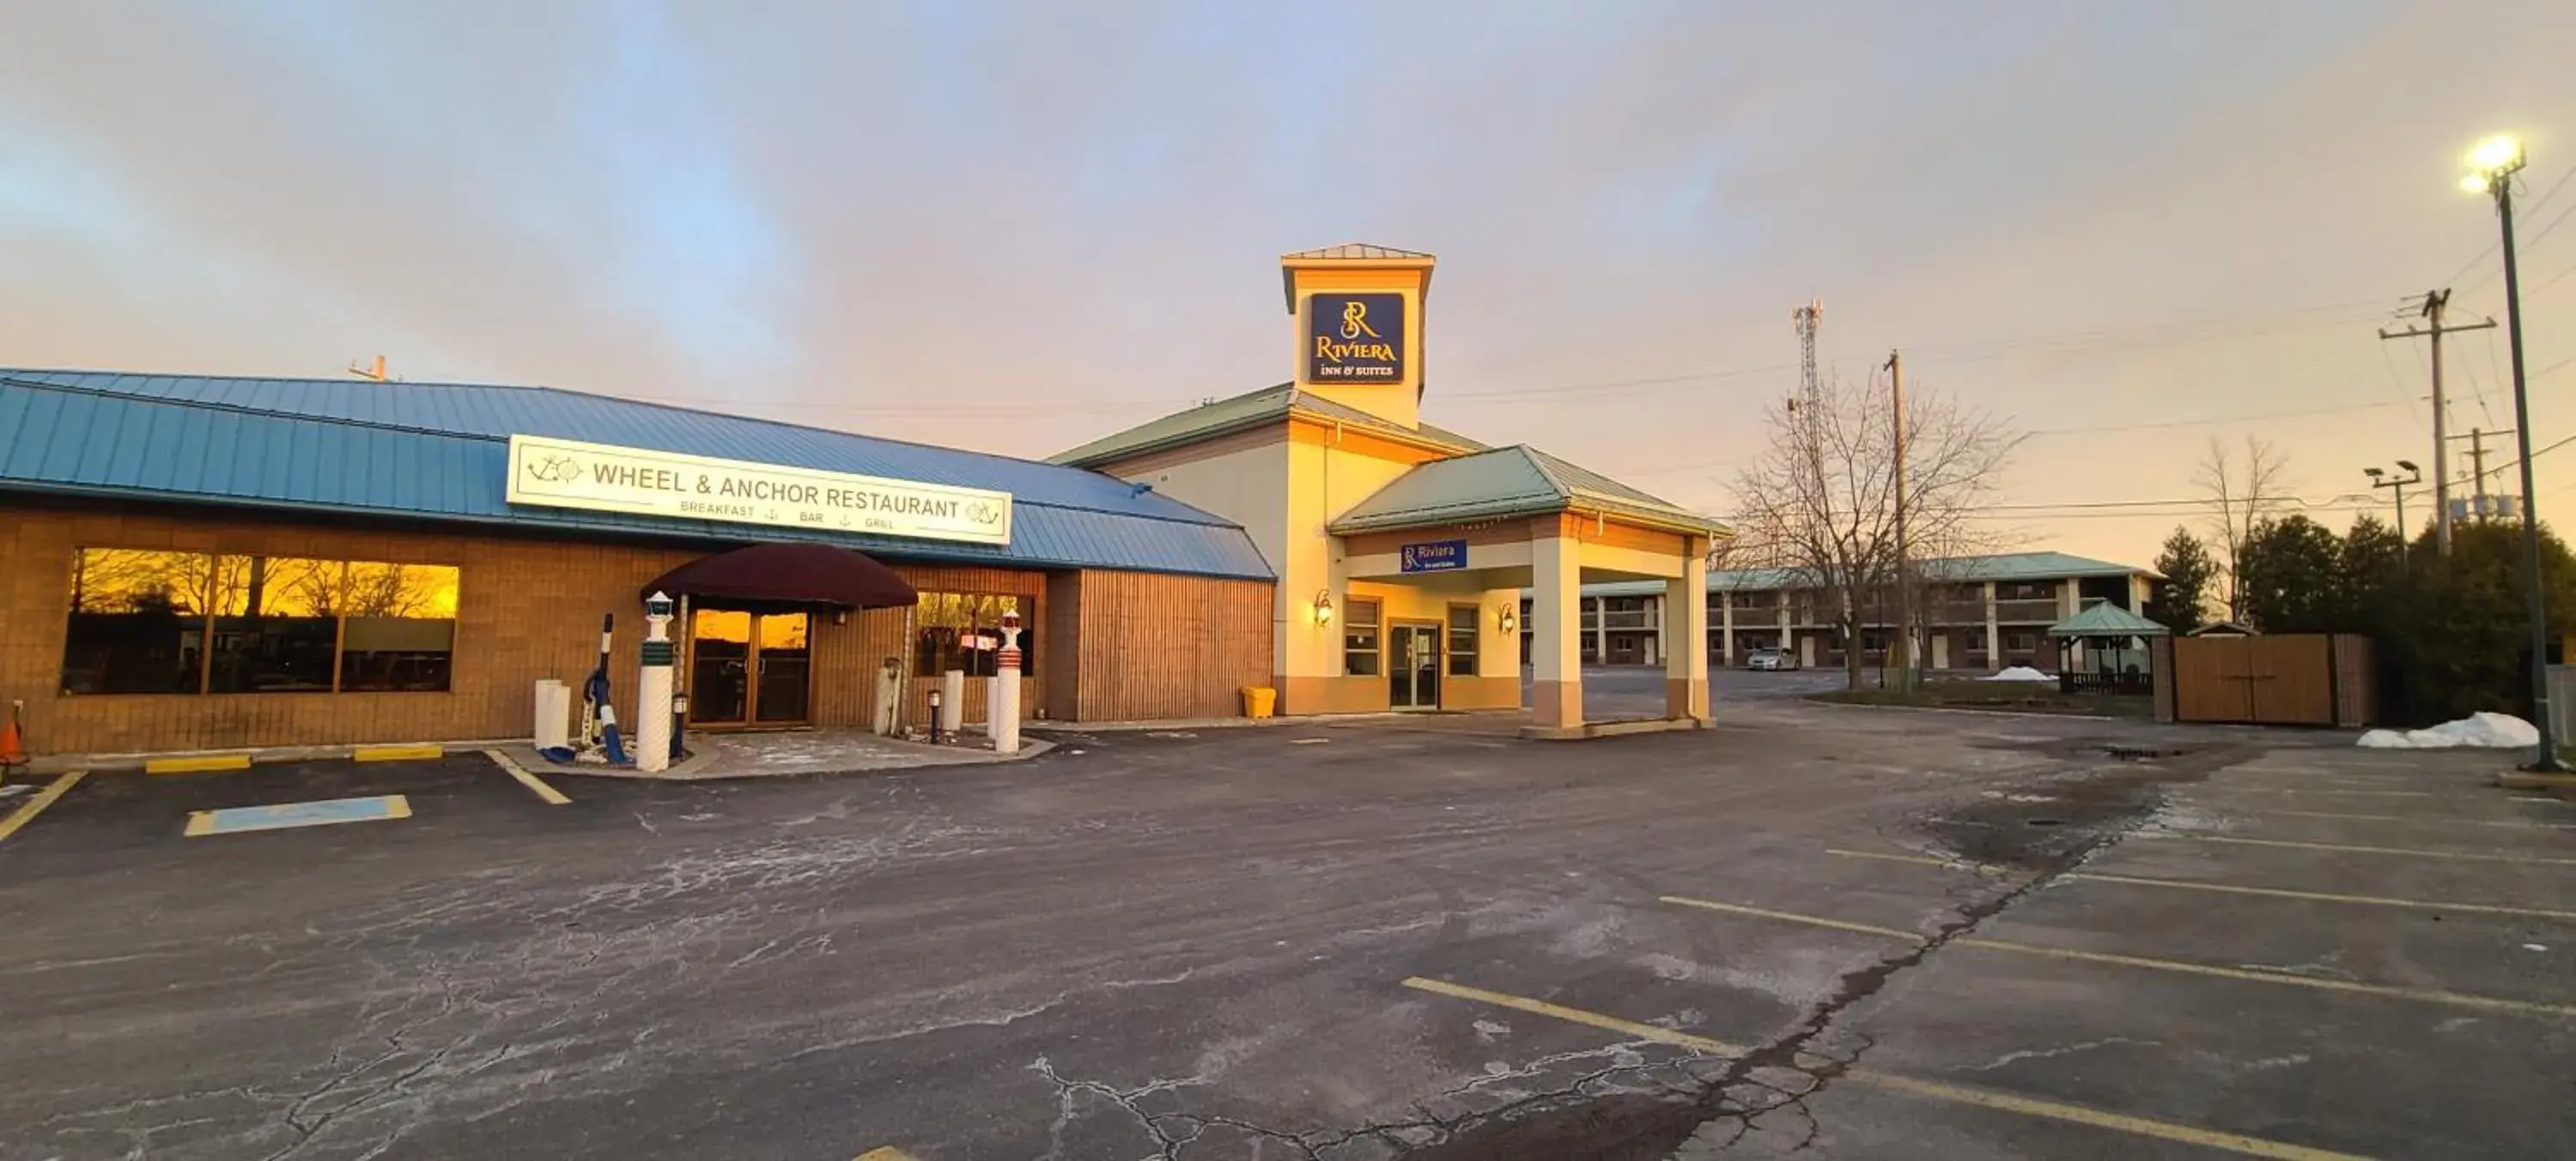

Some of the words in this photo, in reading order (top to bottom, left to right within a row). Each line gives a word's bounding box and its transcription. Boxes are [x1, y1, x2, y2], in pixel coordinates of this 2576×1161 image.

[1321, 364, 1341, 375] INN
[1356, 367, 1394, 375] SUITES
[593, 463, 688, 493] WHEEL
[696, 474, 712, 495] &
[719, 477, 819, 507] ANCHOR
[826, 488, 959, 519] RESTAURANT
[680, 501, 756, 518] BREAKFAST
[799, 511, 824, 523] BAR
[865, 517, 894, 530] GRILL
[1418, 545, 1455, 559] Riviera
